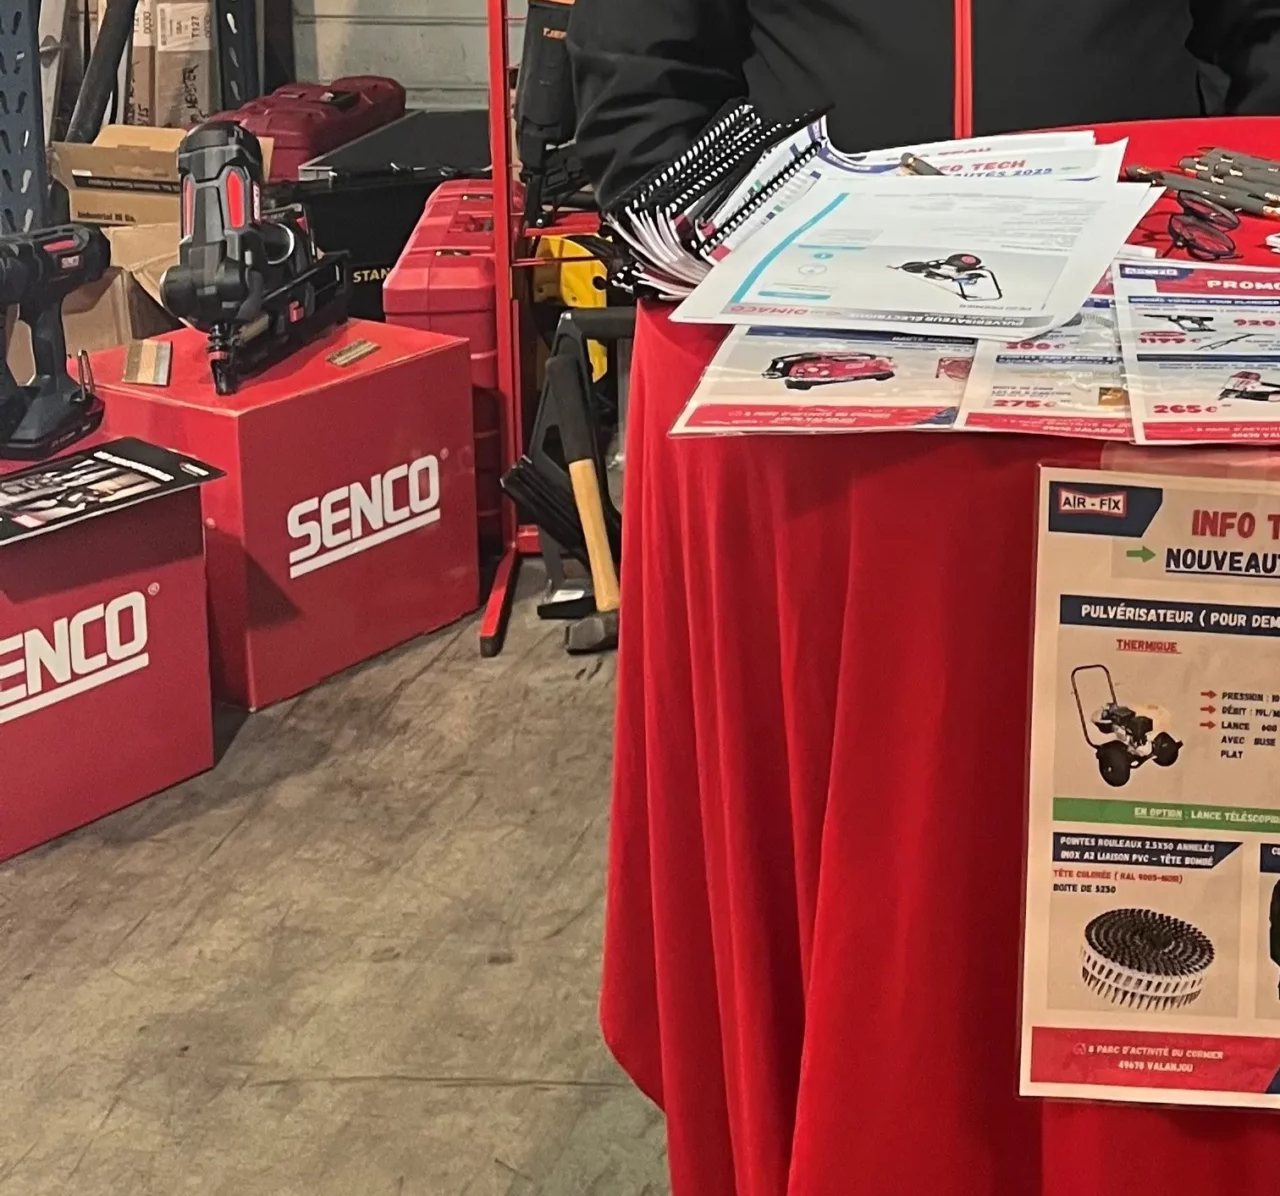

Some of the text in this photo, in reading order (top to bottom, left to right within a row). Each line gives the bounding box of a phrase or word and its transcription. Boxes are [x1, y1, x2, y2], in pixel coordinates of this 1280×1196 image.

[191, 16, 200, 38] T127
[970, 160, 1027, 171] TECH
[352, 266, 392, 284] STAN
[730, 306, 808, 316] DIMACO
[288, 454, 440, 565] SENCO
[1062, 496, 1086, 508] AIR
[1099, 498, 1121, 511] FIX
[1192, 510, 1256, 538] INFO
[1080, 602, 1194, 623] PULVÉRISATEUR
[1210, 612, 1246, 627] POUR
[0, 591, 148, 706] ENCO
[1116, 638, 1178, 652] THERMIQUE
[1222, 692, 1264, 702] PRESSION
[1222, 704, 1247, 715] DÉBIT
[1221, 721, 1250, 731] LANCE
[1221, 736, 1245, 745] AVEC
[1254, 738, 1276, 746] BUSE
[1220, 750, 1243, 759] PLAT
[1134, 808, 1148, 816] EN
[1150, 808, 1183, 819] OPTION
[1191, 810, 1222, 821] LANCE
[1060, 836, 1096, 846] POINTES
[1098, 838, 1142, 848] ROULEAUX
[1097, 852, 1130, 861] LIAISON
[1132, 854, 1149, 863] PVC
[1160, 853, 1182, 864] TÊTE
[1054, 868, 1074, 878] TÊTE
[1120, 872, 1135, 881] RAL
[1081, 884, 1092, 892] DE
[1096, 1045, 1120, 1054] PARC
[1122, 1046, 1169, 1057] D'ACTIVITÉ
[1171, 1049, 1184, 1057] DU
[1186, 1050, 1224, 1059] CORMIER
